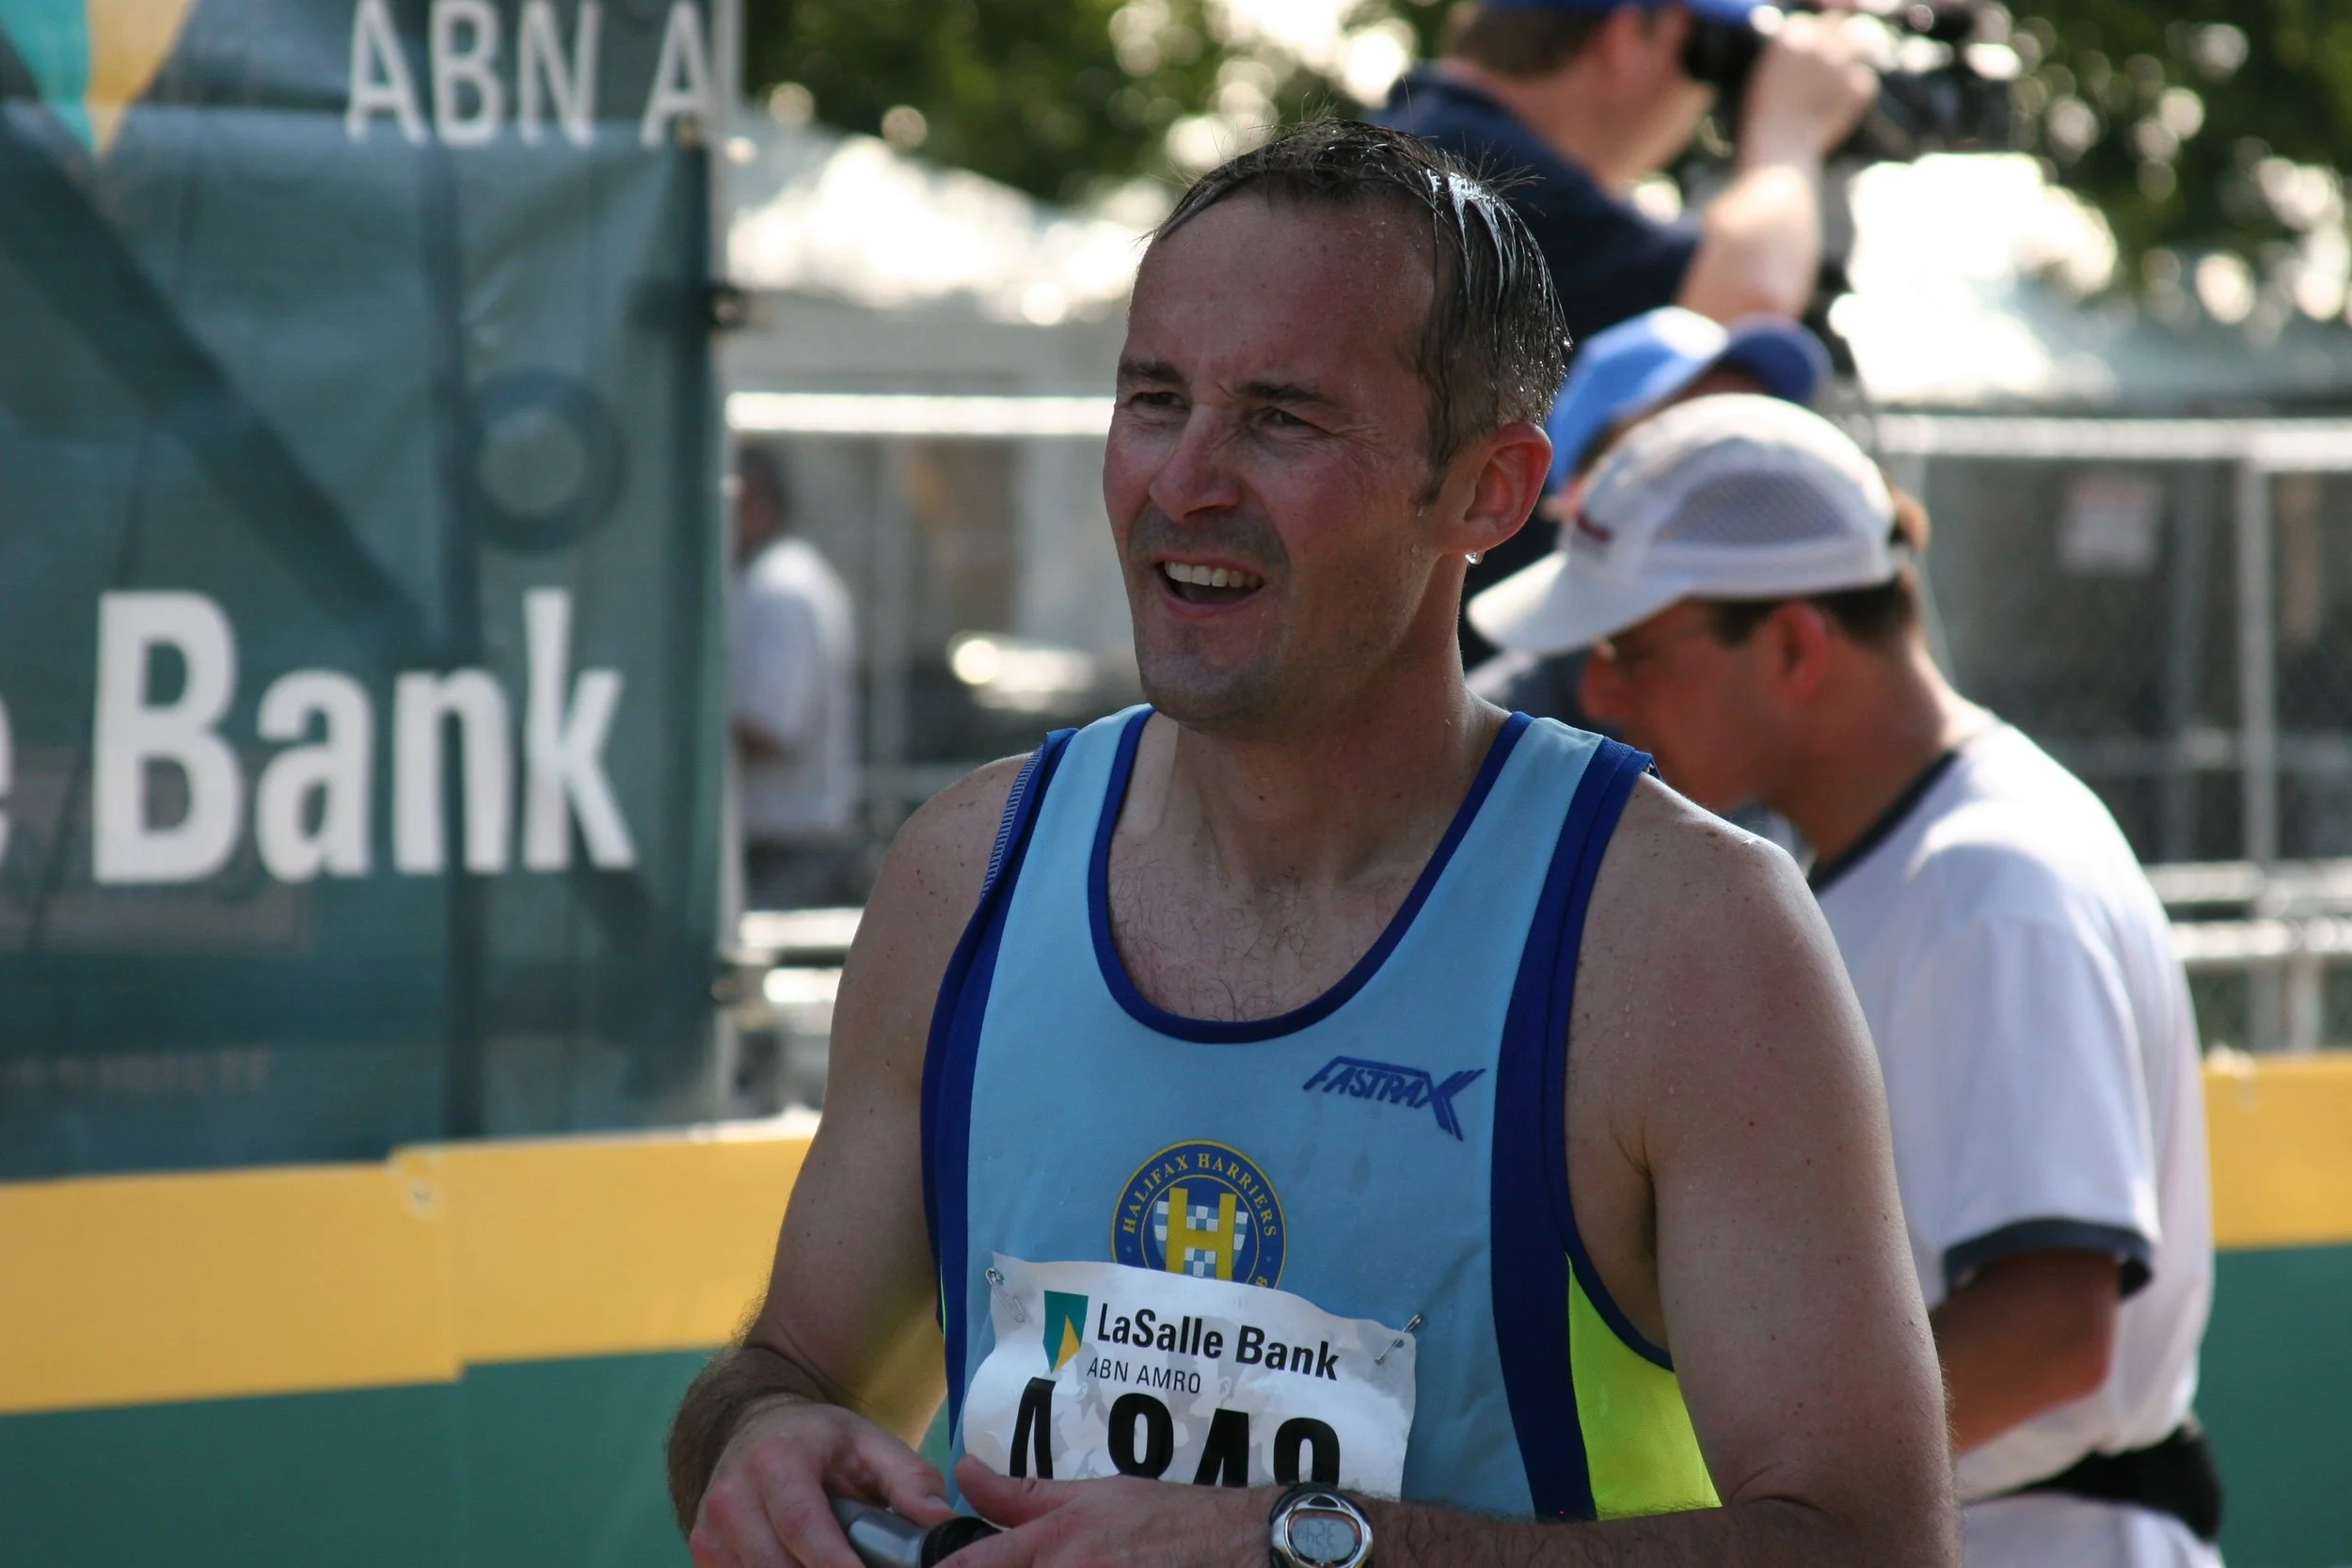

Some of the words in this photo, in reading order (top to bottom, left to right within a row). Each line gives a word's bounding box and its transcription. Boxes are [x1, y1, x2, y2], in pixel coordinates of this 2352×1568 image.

[345, 0, 601, 146] ABN
[92, 587, 639, 883] Bank
[1302, 1055, 1486, 1141] FASTRAX
[1122, 1155, 1189, 1233] HALIFAX
[1198, 1152, 1277, 1237] HARRIERS
[1087, 1357, 1128, 1382] ABN
[1136, 1365, 1200, 1394] AMRO
[1097, 1303, 1223, 1359] LaSalle
[1235, 1324, 1340, 1381] Bank
